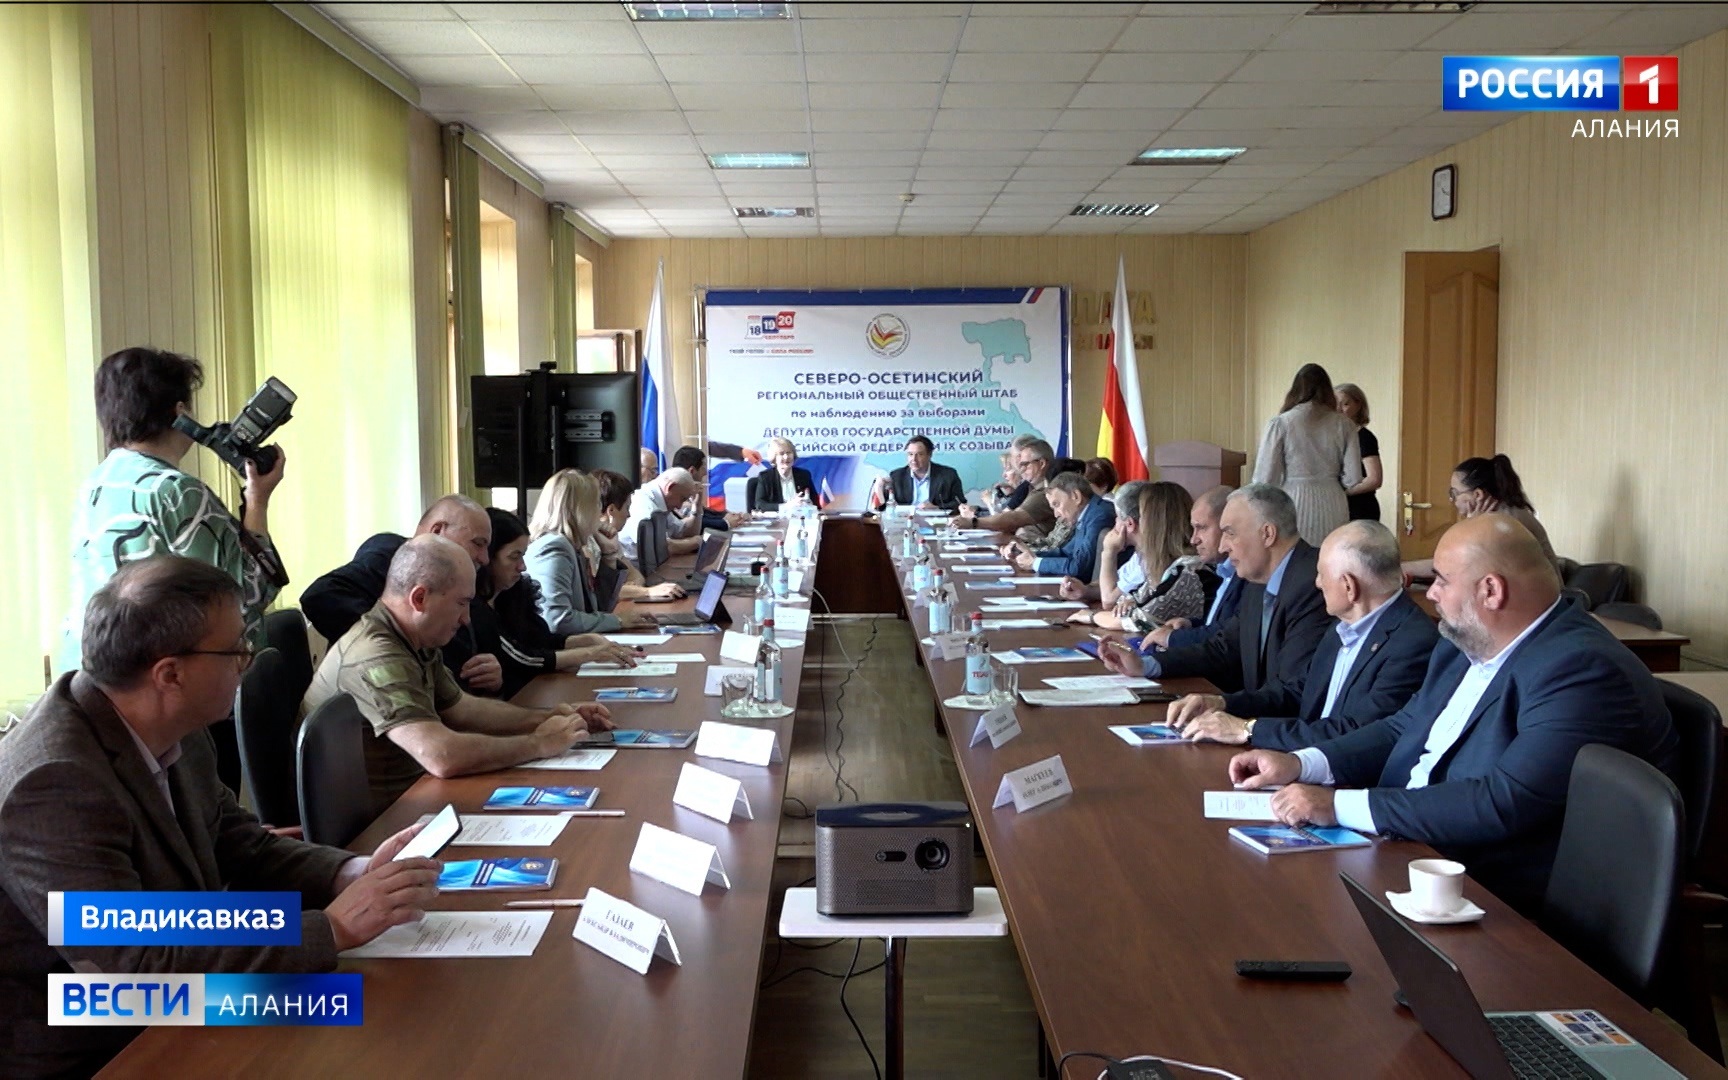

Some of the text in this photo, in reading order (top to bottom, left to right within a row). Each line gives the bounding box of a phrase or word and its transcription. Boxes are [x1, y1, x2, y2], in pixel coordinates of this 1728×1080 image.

[749, 325, 761, 336] 18
[777, 315, 793, 326] 20
[794, 369, 983, 384] СЕВЕРО-ОСЕТИНСКИЙ
[757, 387, 1018, 401] РЕГИОНАЛЬНЫЙ ОБЩЕСТВЕННЫЙ ШТАБ
[791, 407, 986, 419] по наблюдению за выборами
[763, 424, 1014, 438] ДЕПУТАТОВ ГОСУДАРСТВЕННОЙ ДУМЫ
[859, 440, 940, 452] ФЕДЕРИ
[959, 440, 1012, 450] СОЗЫВА
